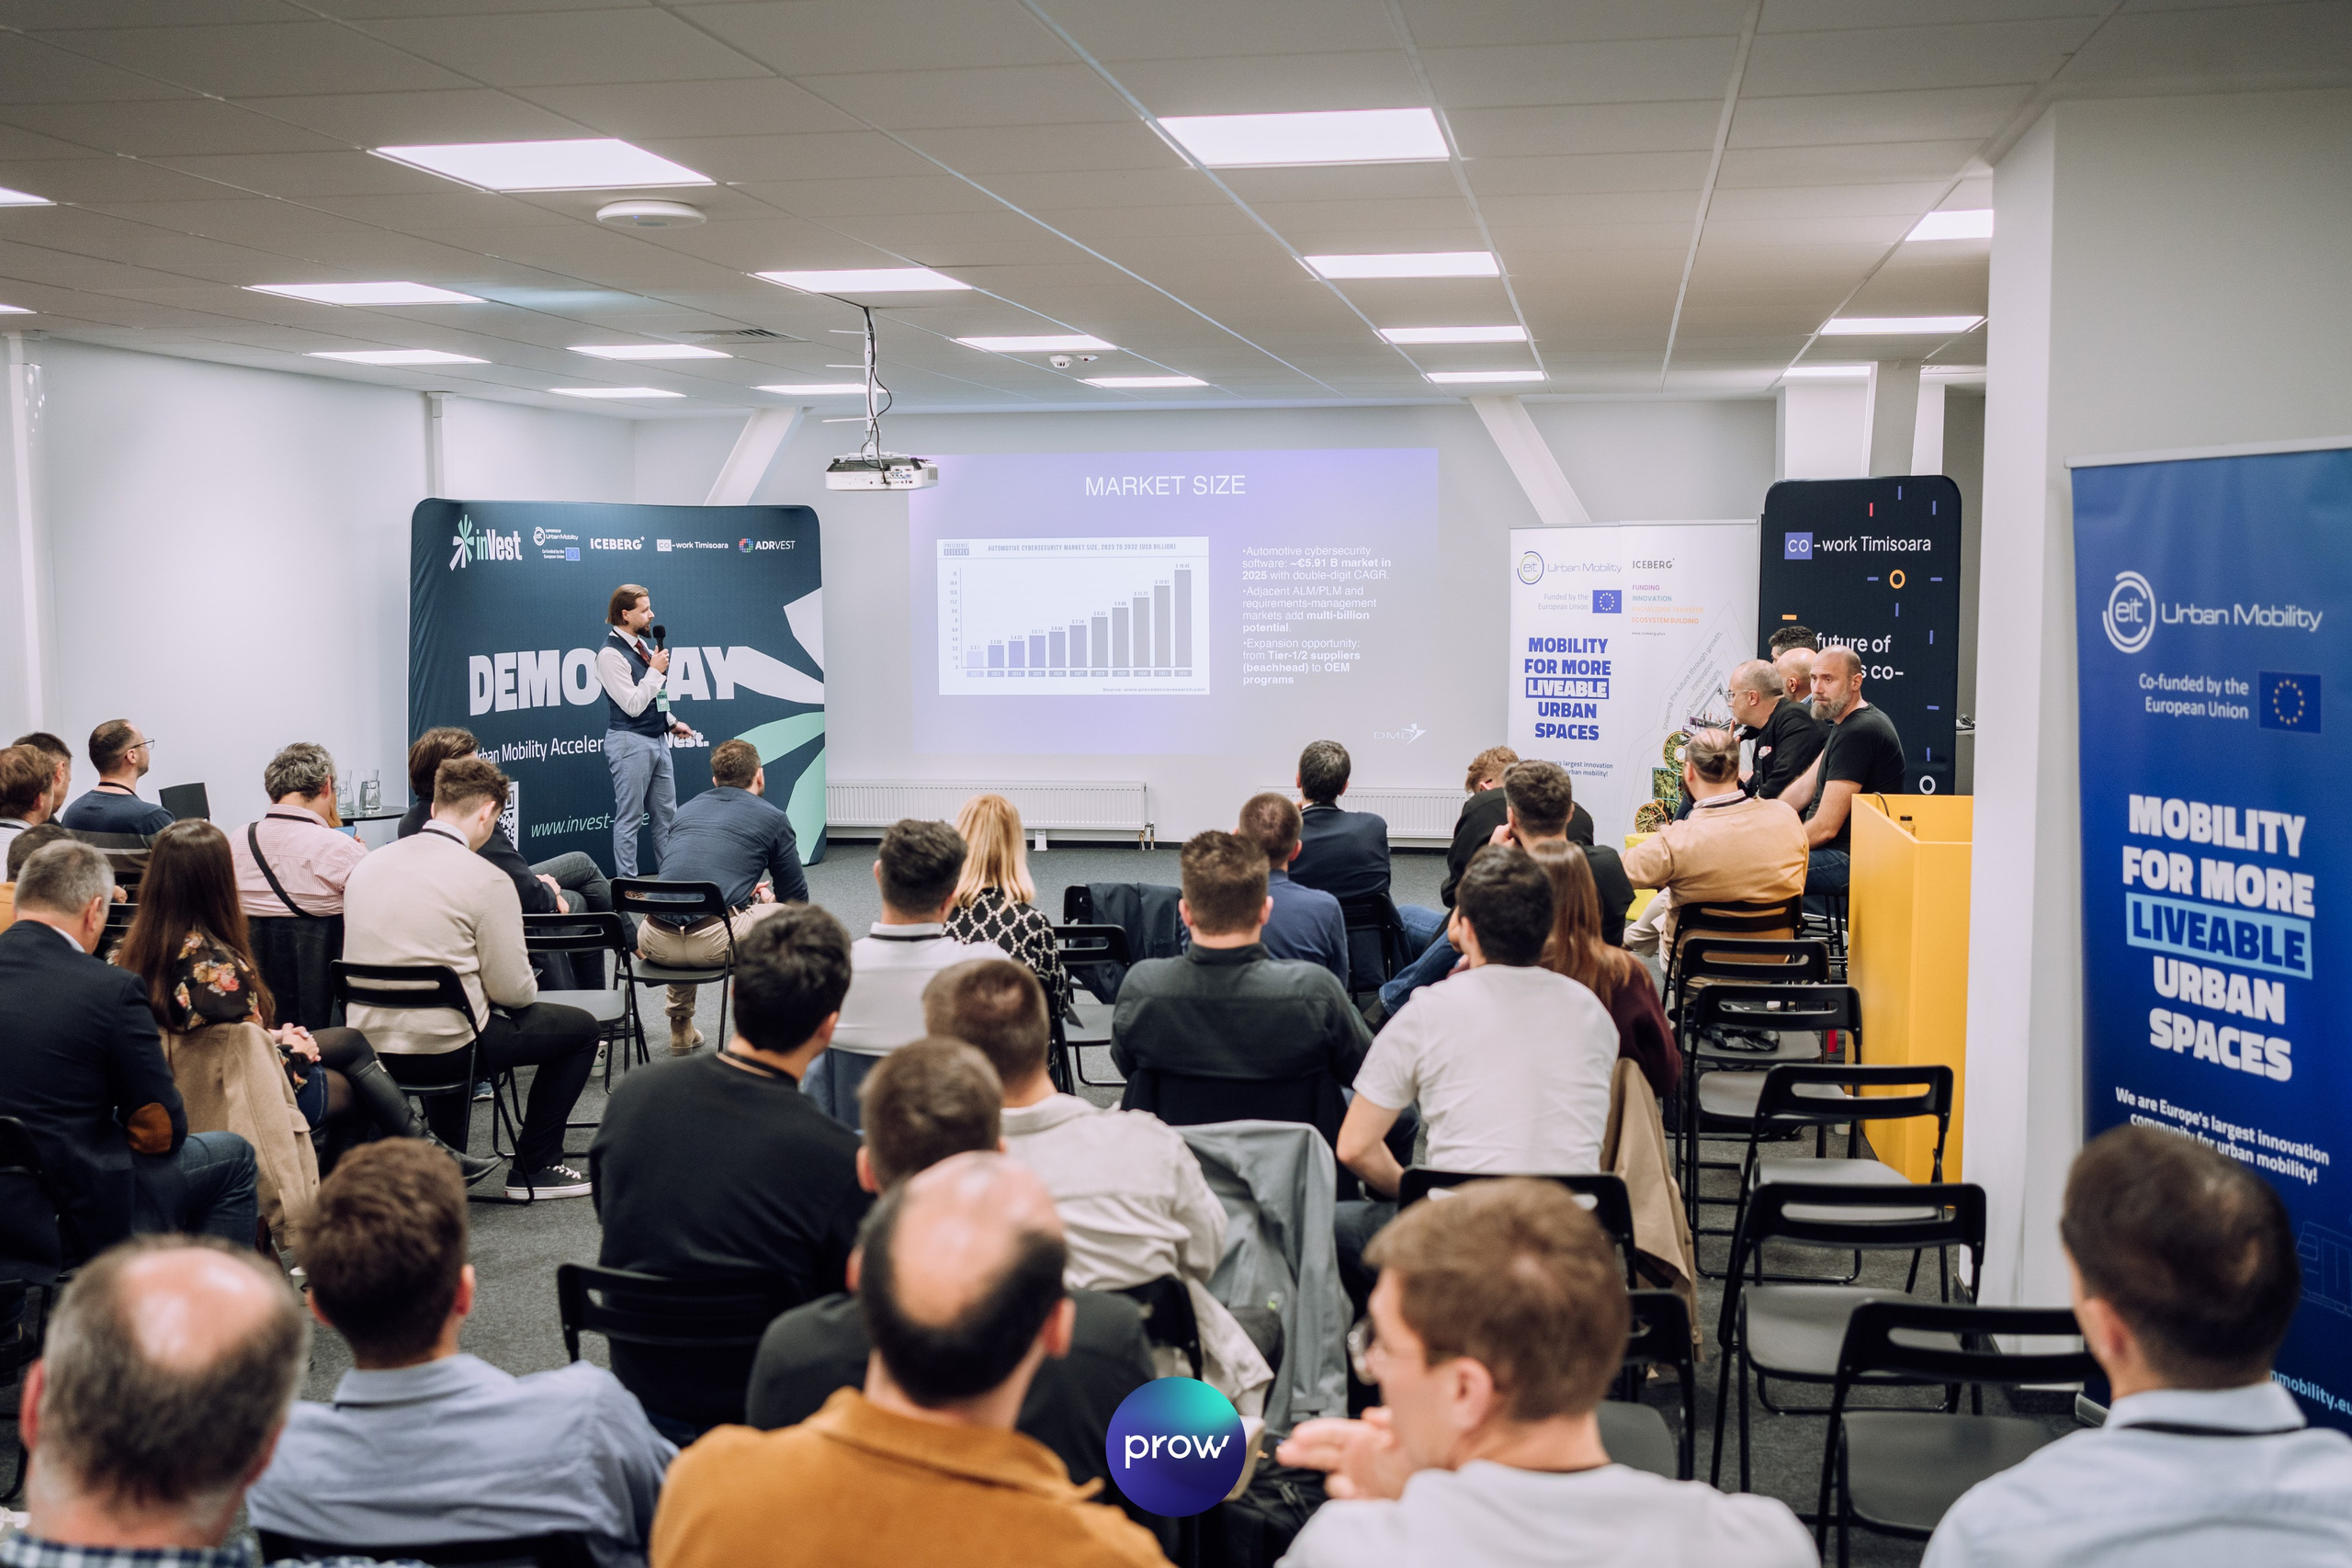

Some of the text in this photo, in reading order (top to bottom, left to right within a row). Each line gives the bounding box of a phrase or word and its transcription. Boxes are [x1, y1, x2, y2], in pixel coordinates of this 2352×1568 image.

[1085, 475, 1246, 496] MARKET SIZE
[476, 529, 523, 560] inVest
[590, 537, 642, 550] ICEBERG
[695, 541, 729, 549] Timisoara
[755, 540, 796, 550] ADRVEST
[1304, 546, 1371, 557] cybersecurity
[1860, 536, 1931, 552] Timisoara
[1242, 558, 1287, 569] software:
[1330, 558, 1338, 568] B
[1341, 558, 1378, 568] market
[1381, 558, 1391, 567] in
[1547, 563, 1580, 572] Urban
[1582, 563, 1623, 573] Mobility
[1632, 560, 1673, 569] ICEBERG
[1242, 570, 1390, 581] 2025 with double-digit CAGR.
[1246, 586, 1363, 597] Adjacent ALM/PLM and
[1242, 598, 1376, 610] requirements-management
[1242, 611, 1370, 620] markets add multi-billion
[2161, 603, 2229, 626] Urban
[2233, 604, 2323, 632] Mobility
[1242, 623, 1292, 634] potential.
[1247, 638, 1360, 650] Expansion opportunity:
[1529, 637, 1609, 654] MOBILITY
[1815, 632, 1892, 653] future of
[1242, 650, 1361, 662] from Tier-1/2 suppliers
[1243, 662, 1350, 673] (beachhead) to OEM
[1524, 659, 1611, 676] FOR MORE
[1691, 660, 1714, 691] innovation
[1871, 665, 1904, 680] co-
[469, 648, 603, 716] DEMO
[1243, 676, 1294, 686] programs
[1528, 679, 1608, 698] LIVEABLE
[2139, 672, 2249, 697] Co-funded by the
[1663, 701, 1673, 730] Shaping
[1669, 691, 1678, 702] the
[1676, 672, 1690, 693] future
[1689, 652, 1708, 676] through
[1690, 689, 1707, 710] human
[1538, 701, 1597, 718] URBAN
[2145, 696, 2249, 719] European Union
[1374, 731, 1414, 739] DMD
[1534, 722, 1600, 740] SPACES
[663, 732, 709, 749] Vest.
[475, 735, 604, 765] rban Mobility Acceler
[1563, 761, 1583, 769] largest
[2129, 794, 2306, 858] MOBILITY
[2122, 845, 2315, 919] FOR MORE
[2132, 900, 2306, 972] LIVEABLE
[2154, 955, 2286, 1026] URBAN
[2148, 1007, 2293, 1082] SPACES
[2115, 1086, 2330, 1167] We are Europe's largest innovation
[2217, 1141, 2255, 1164] urban
[2256, 1150, 2318, 1186] mobility!
[2269, 1370, 2352, 1416] nmobility.eu
